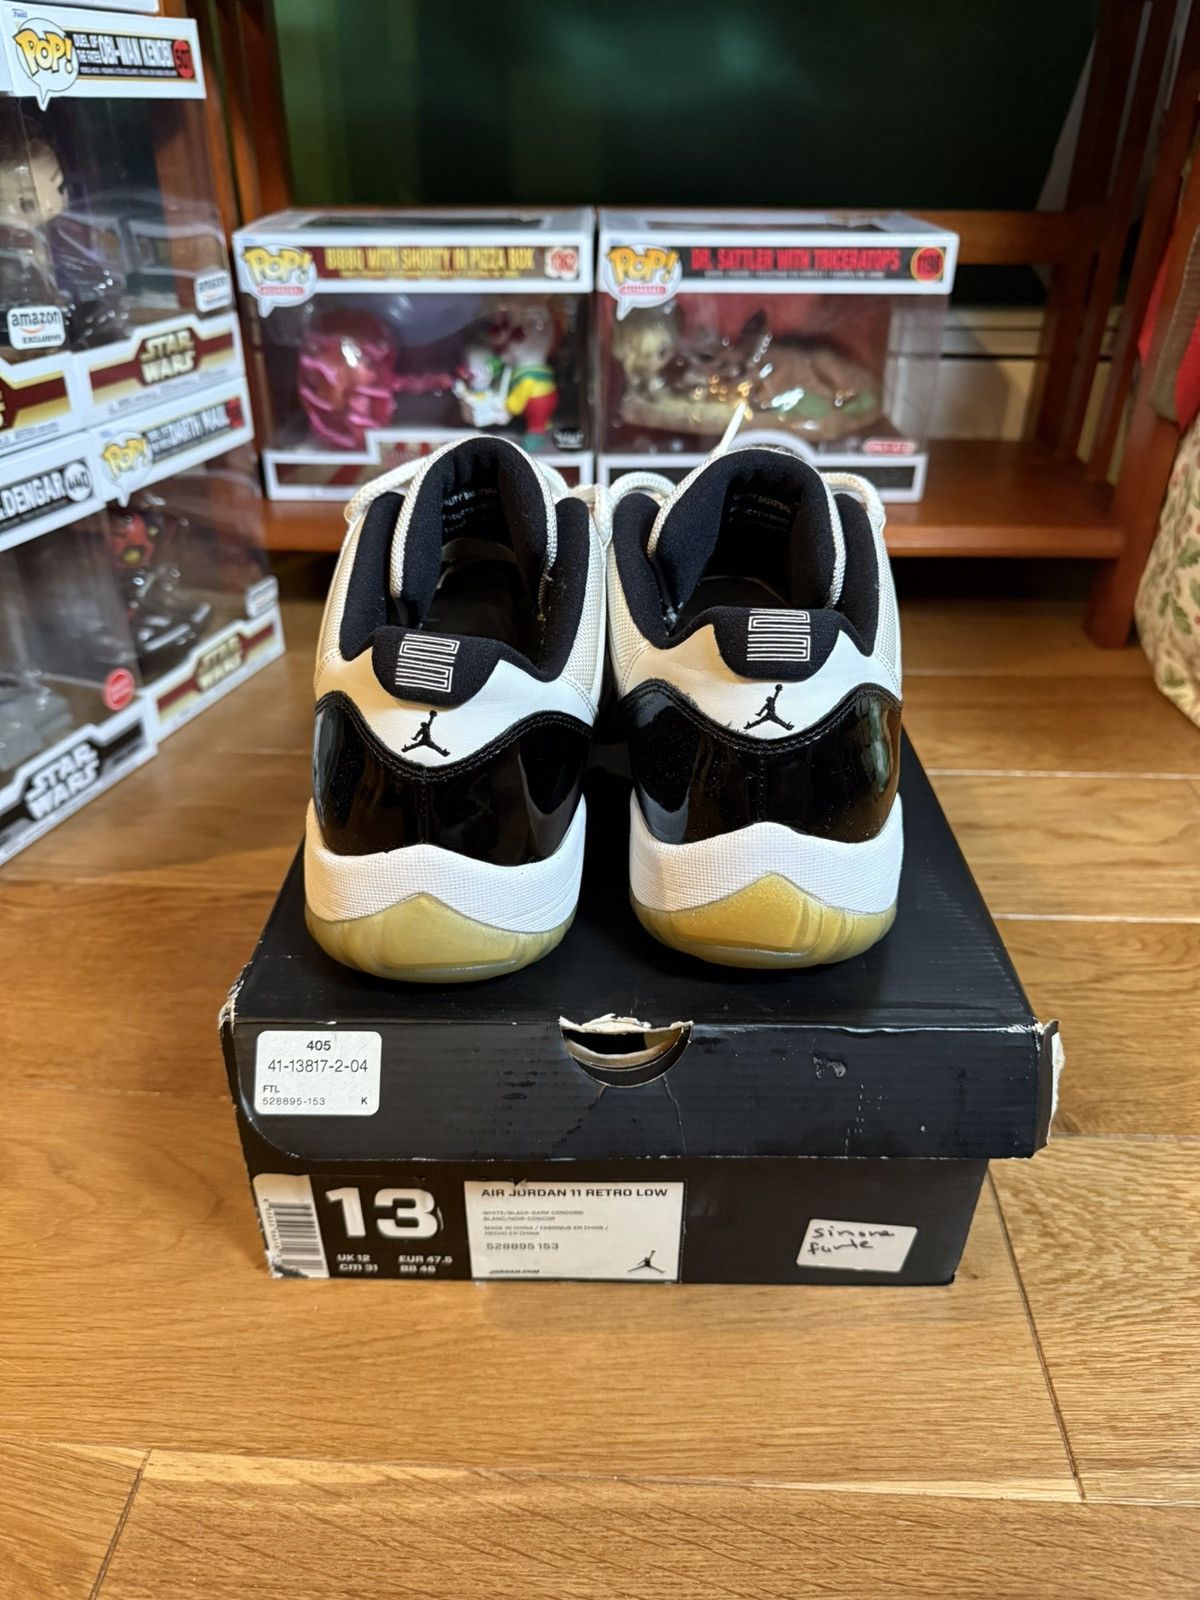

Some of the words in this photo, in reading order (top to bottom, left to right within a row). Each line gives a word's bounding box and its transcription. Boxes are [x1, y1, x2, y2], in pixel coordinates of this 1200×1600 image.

[13, 28, 73, 76] POP!
[242, 247, 312, 284] POP!
[608, 247, 679, 284] POP!
[11, 311, 60, 327] amazon
[141, 330, 195, 362] STAR
[142, 350, 196, 383] WARS
[26, 744, 97, 800] STAR
[26, 762, 99, 820] WARS
[306, 1040, 331, 1051] 405
[267, 1059, 368, 1073] 41-13817-2-04
[263, 1085, 280, 1093] FTL
[262, 1097, 325, 1106] 528895-153
[360, 1097, 368, 1105] K
[481, 1188, 505, 1197] AIR
[509, 1188, 567, 1198] JORDAN
[570, 1188, 582, 1197] 11
[584, 1188, 633, 1198] RETRO
[636, 1188, 668, 1198] LOW
[325, 1187, 438, 1240] 13
[486, 1242, 535, 1250] 528895
[538, 1242, 559, 1250] 153
[336, 1254, 355, 1262] UK
[356, 1254, 371, 1262] 12
[398, 1255, 425, 1264] EUR
[426, 1255, 453, 1265] 47.5
[364, 1263, 379, 1272] 31
[419, 1264, 437, 1273] 46
